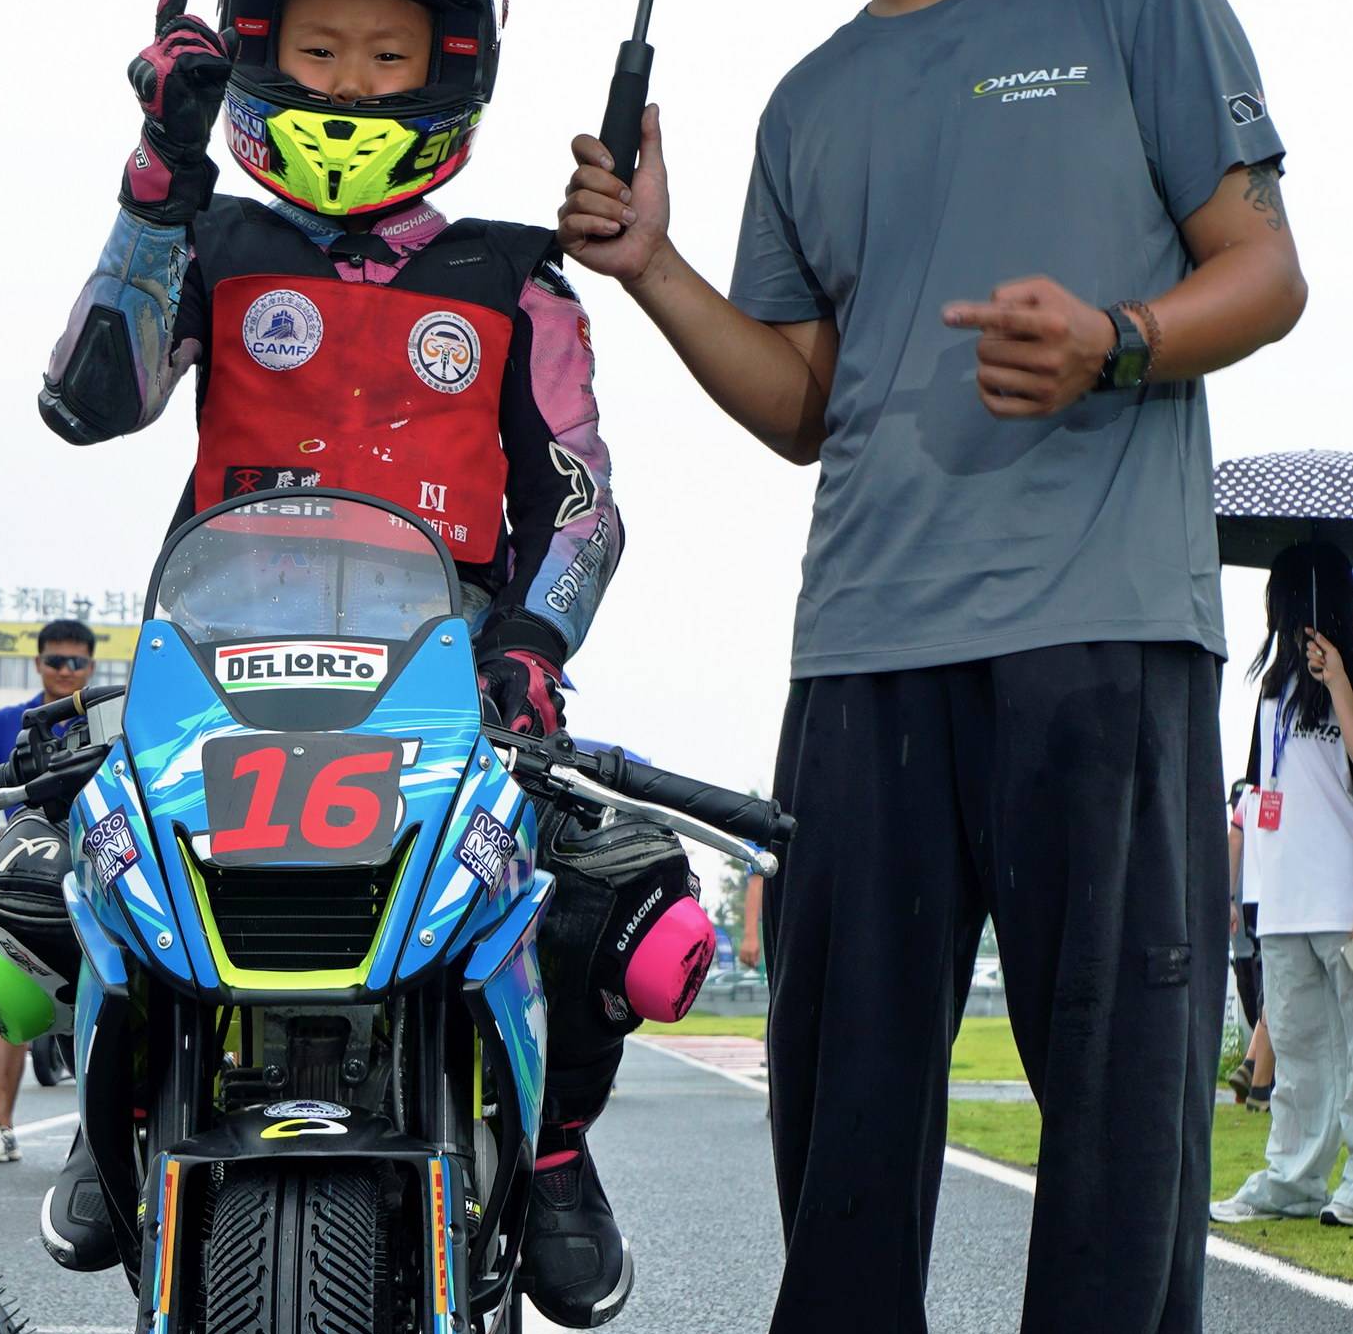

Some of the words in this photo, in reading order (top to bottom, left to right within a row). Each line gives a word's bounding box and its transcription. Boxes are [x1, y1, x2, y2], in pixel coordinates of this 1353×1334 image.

[974, 66, 1088, 94] OHVALE
[1001, 87, 1057, 102] CHINA
[231, 123, 268, 168] MOLY
[381, 208, 438, 237] MOCHAKN
[253, 342, 308, 357] CAMF
[227, 654, 374, 681] DELLORTO
[212, 747, 394, 854] 16
[616, 933, 630, 952] GJ
[626, 887, 663, 935] RACING
